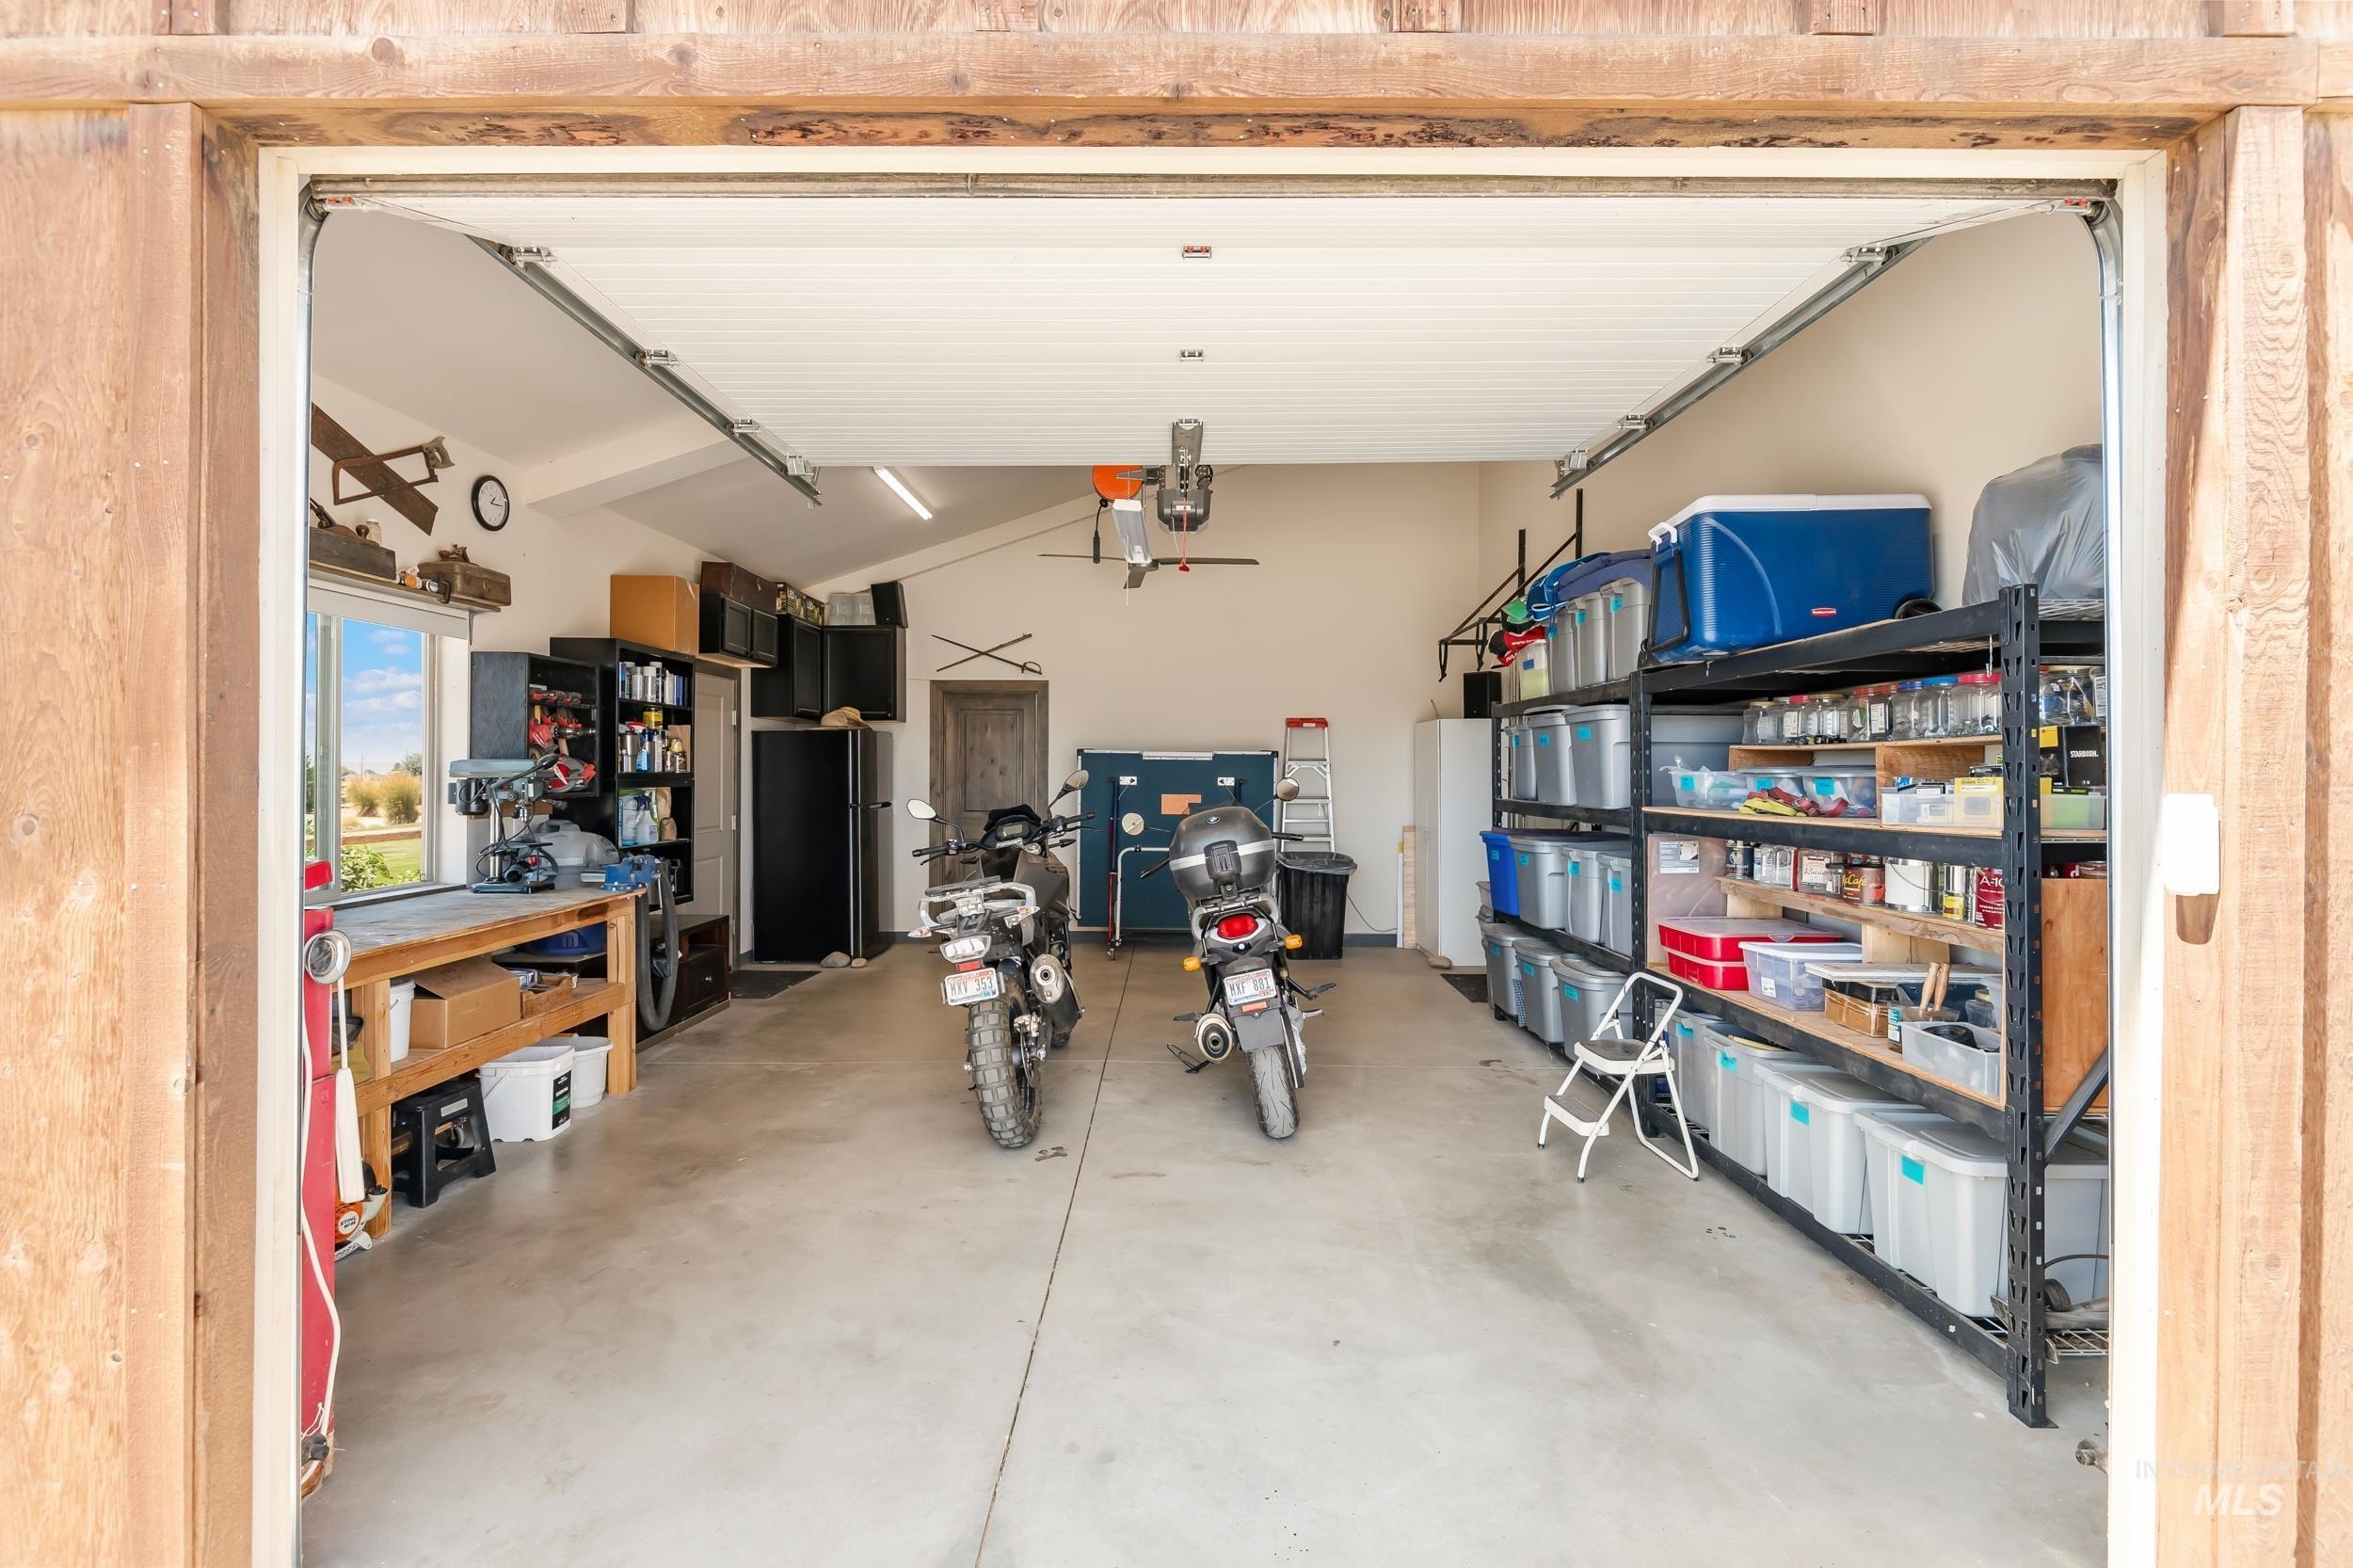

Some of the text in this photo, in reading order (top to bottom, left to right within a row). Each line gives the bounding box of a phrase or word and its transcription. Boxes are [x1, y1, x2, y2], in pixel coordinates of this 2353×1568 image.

[787, 588, 795, 600] LED
[951, 976, 993, 997] MXV 353
[1229, 977, 1271, 997] MXF 881
[340, 1216, 357, 1226] STIHL
